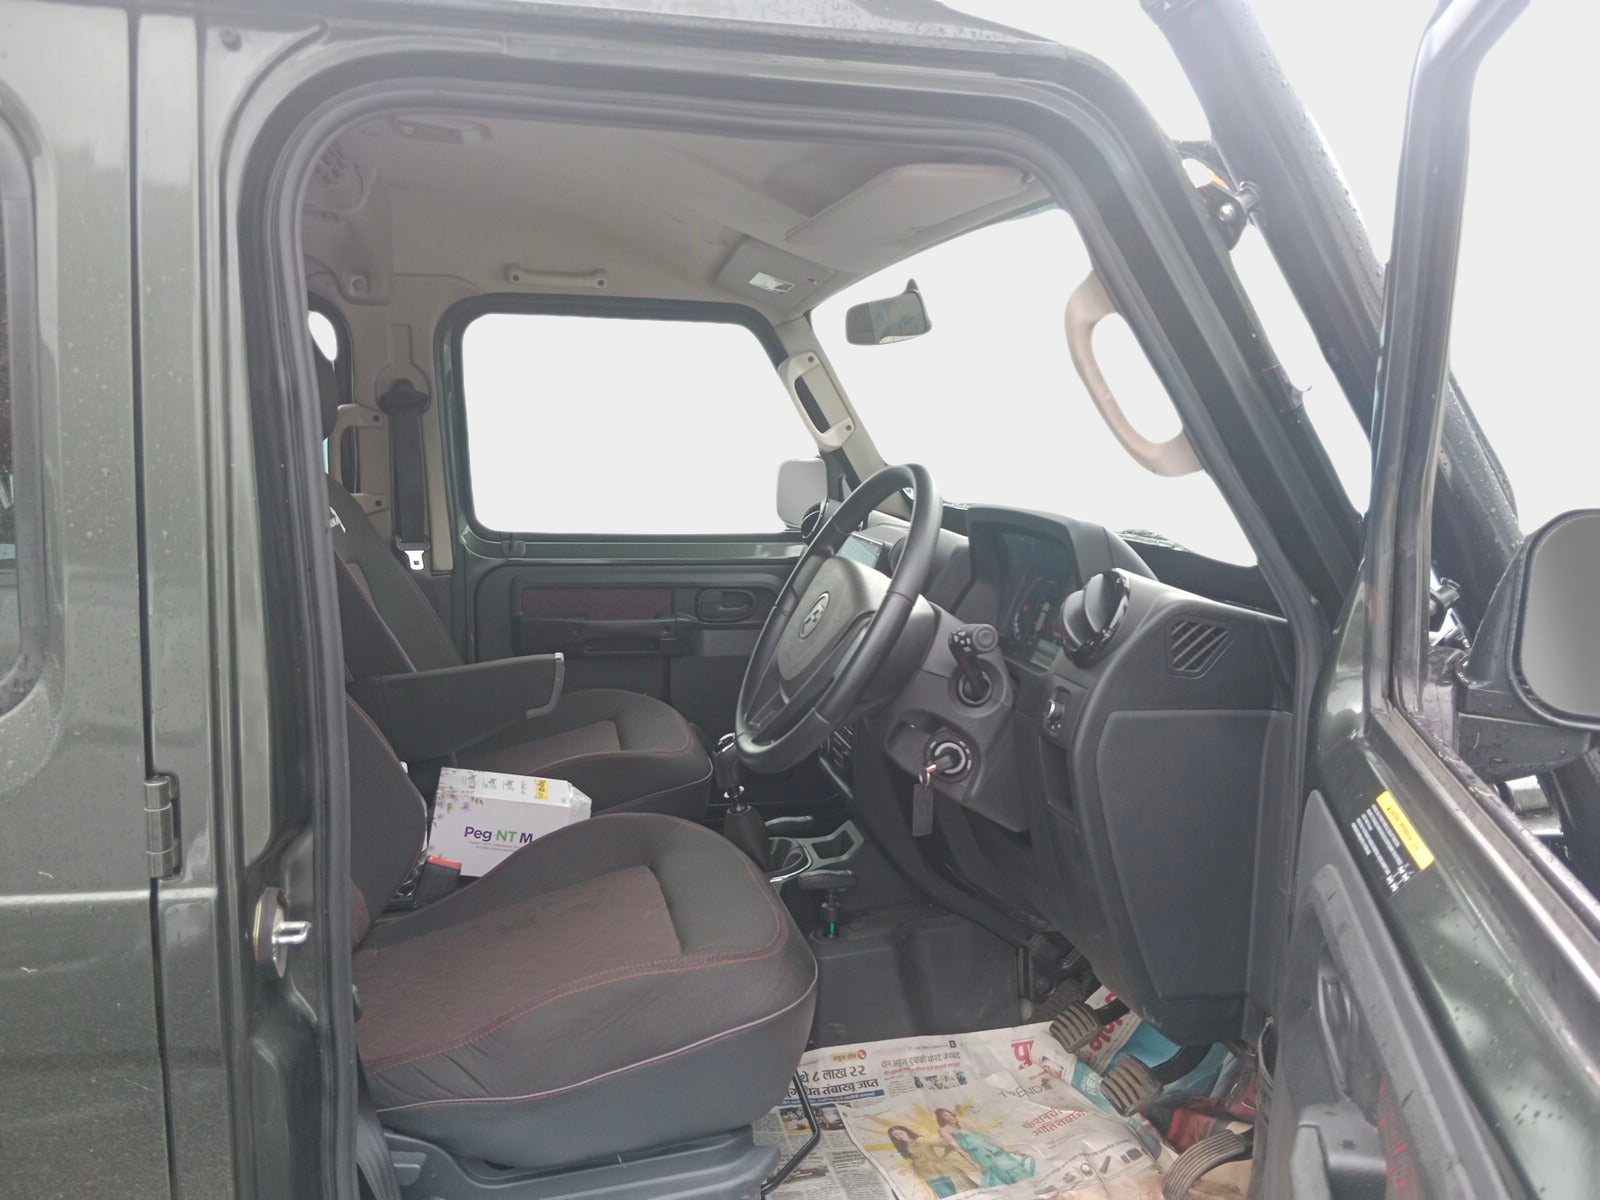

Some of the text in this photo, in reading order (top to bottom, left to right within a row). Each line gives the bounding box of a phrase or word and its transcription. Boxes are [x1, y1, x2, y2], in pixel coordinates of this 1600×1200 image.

[464, 826, 492, 842] Peg
[496, 829, 517, 842] NT
[822, 1068, 847, 1080] लाख
[849, 1066, 866, 1077] २२
[857, 1078, 879, 1090] जप्त
